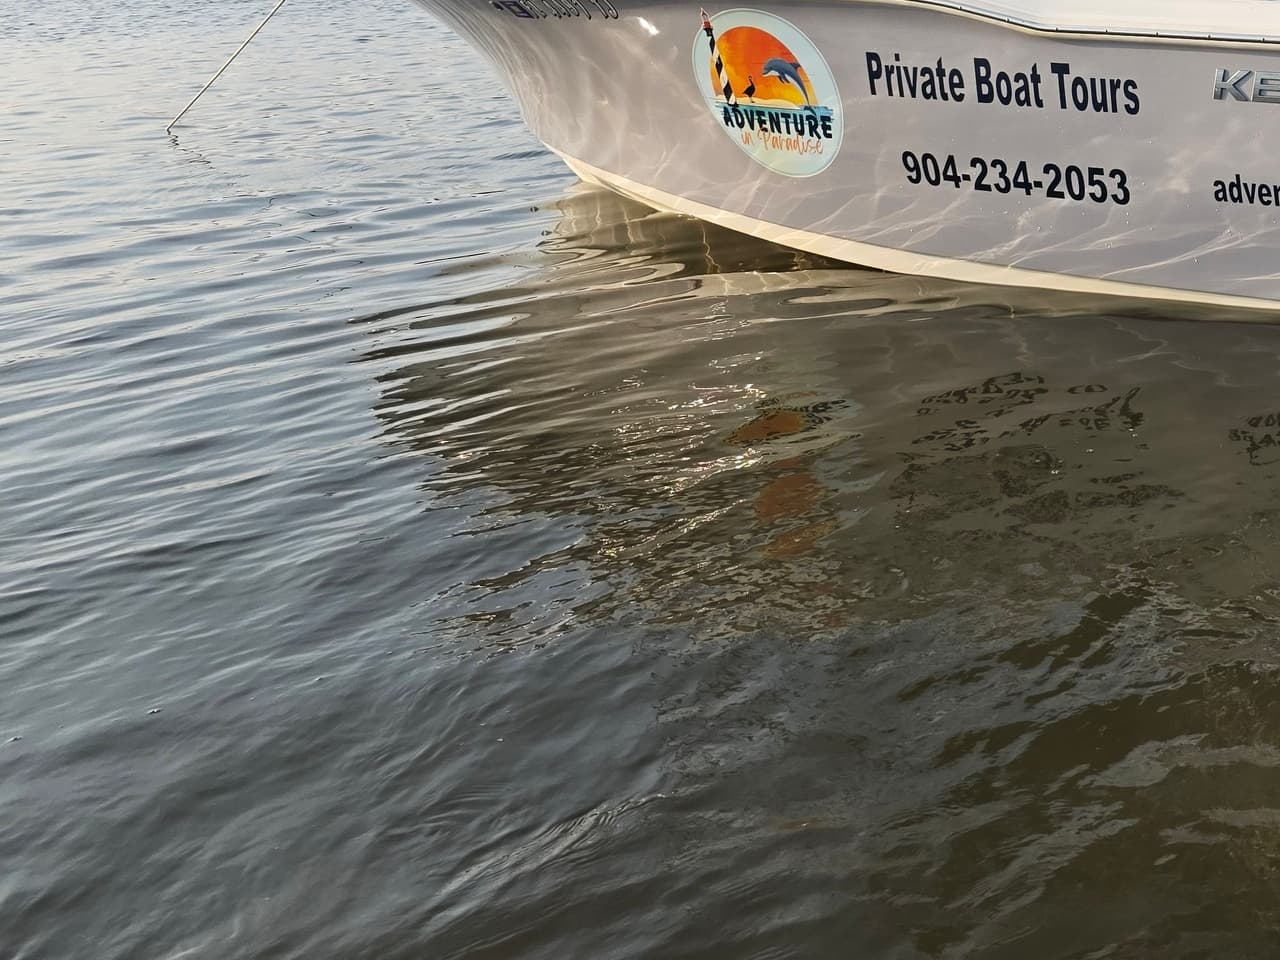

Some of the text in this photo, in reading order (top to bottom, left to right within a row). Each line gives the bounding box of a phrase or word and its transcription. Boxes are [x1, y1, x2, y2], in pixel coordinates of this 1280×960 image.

[866, 51, 1140, 116] Private Boat Tours
[722, 106, 833, 140] ADVENTURE
[741, 129, 824, 155] in Paradise
[901, 150, 1130, 206] 904-234-2053
